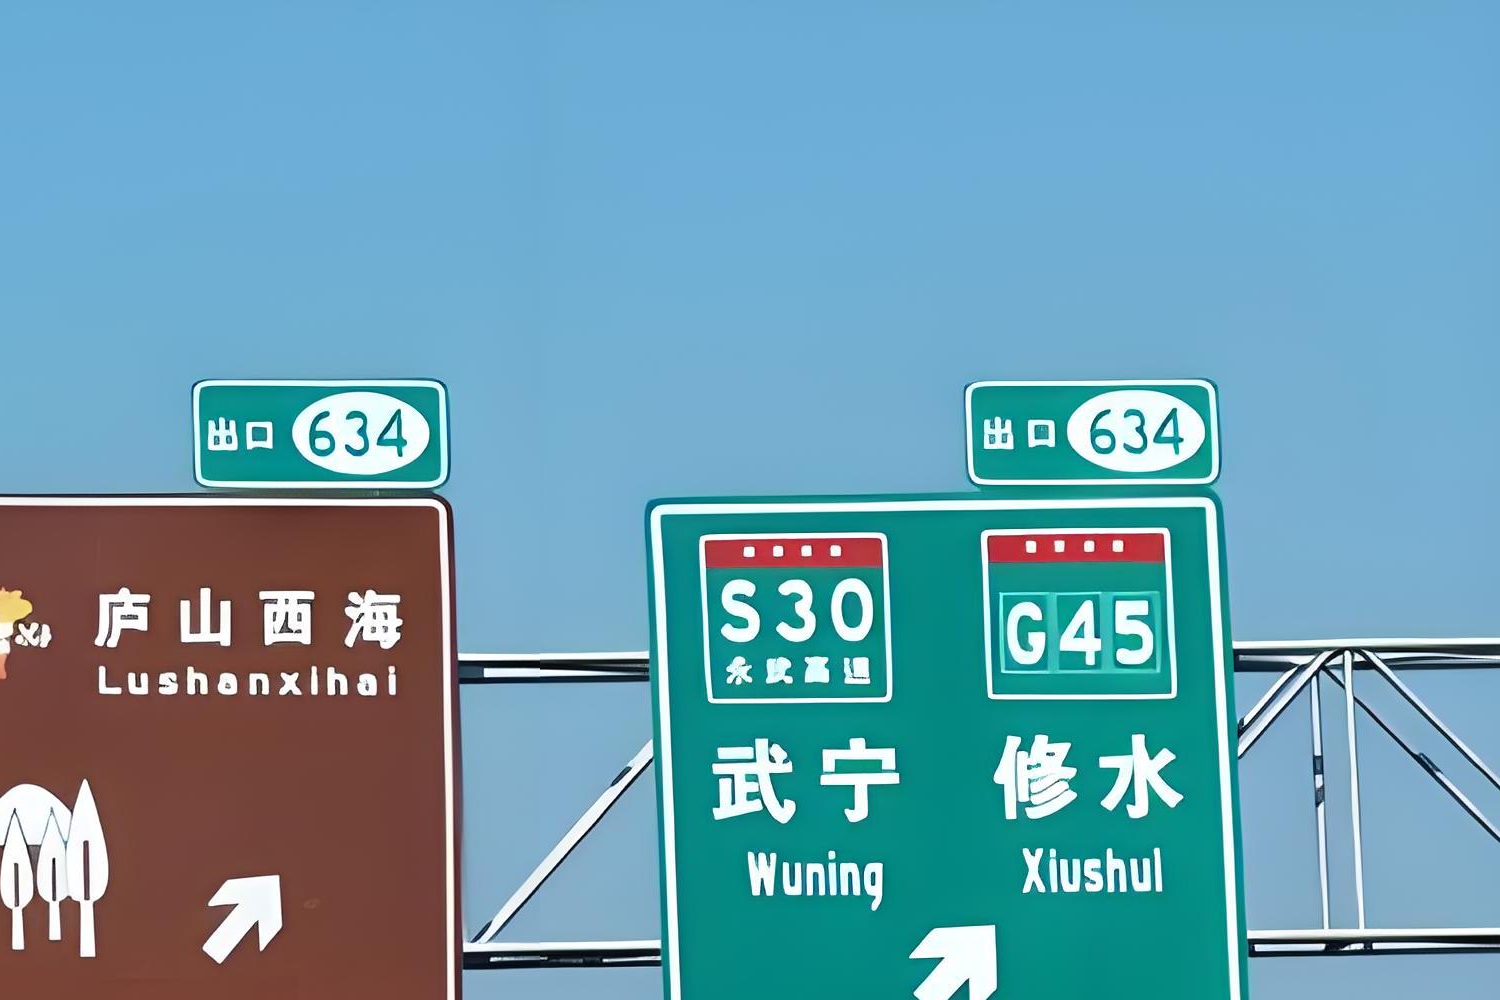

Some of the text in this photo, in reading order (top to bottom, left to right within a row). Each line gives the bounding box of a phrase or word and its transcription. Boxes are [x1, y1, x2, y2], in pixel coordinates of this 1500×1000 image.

[207, 408, 408, 458] 出口 634
[983, 407, 1185, 455] 出口 634
[94, 587, 403, 650] 庐山西海
[720, 578, 874, 643] S30
[1006, 599, 1154, 666] G45
[711, 737, 900, 824] 武宁
[993, 733, 1184, 820] 修水
[747, 850, 884, 911] Wuning
